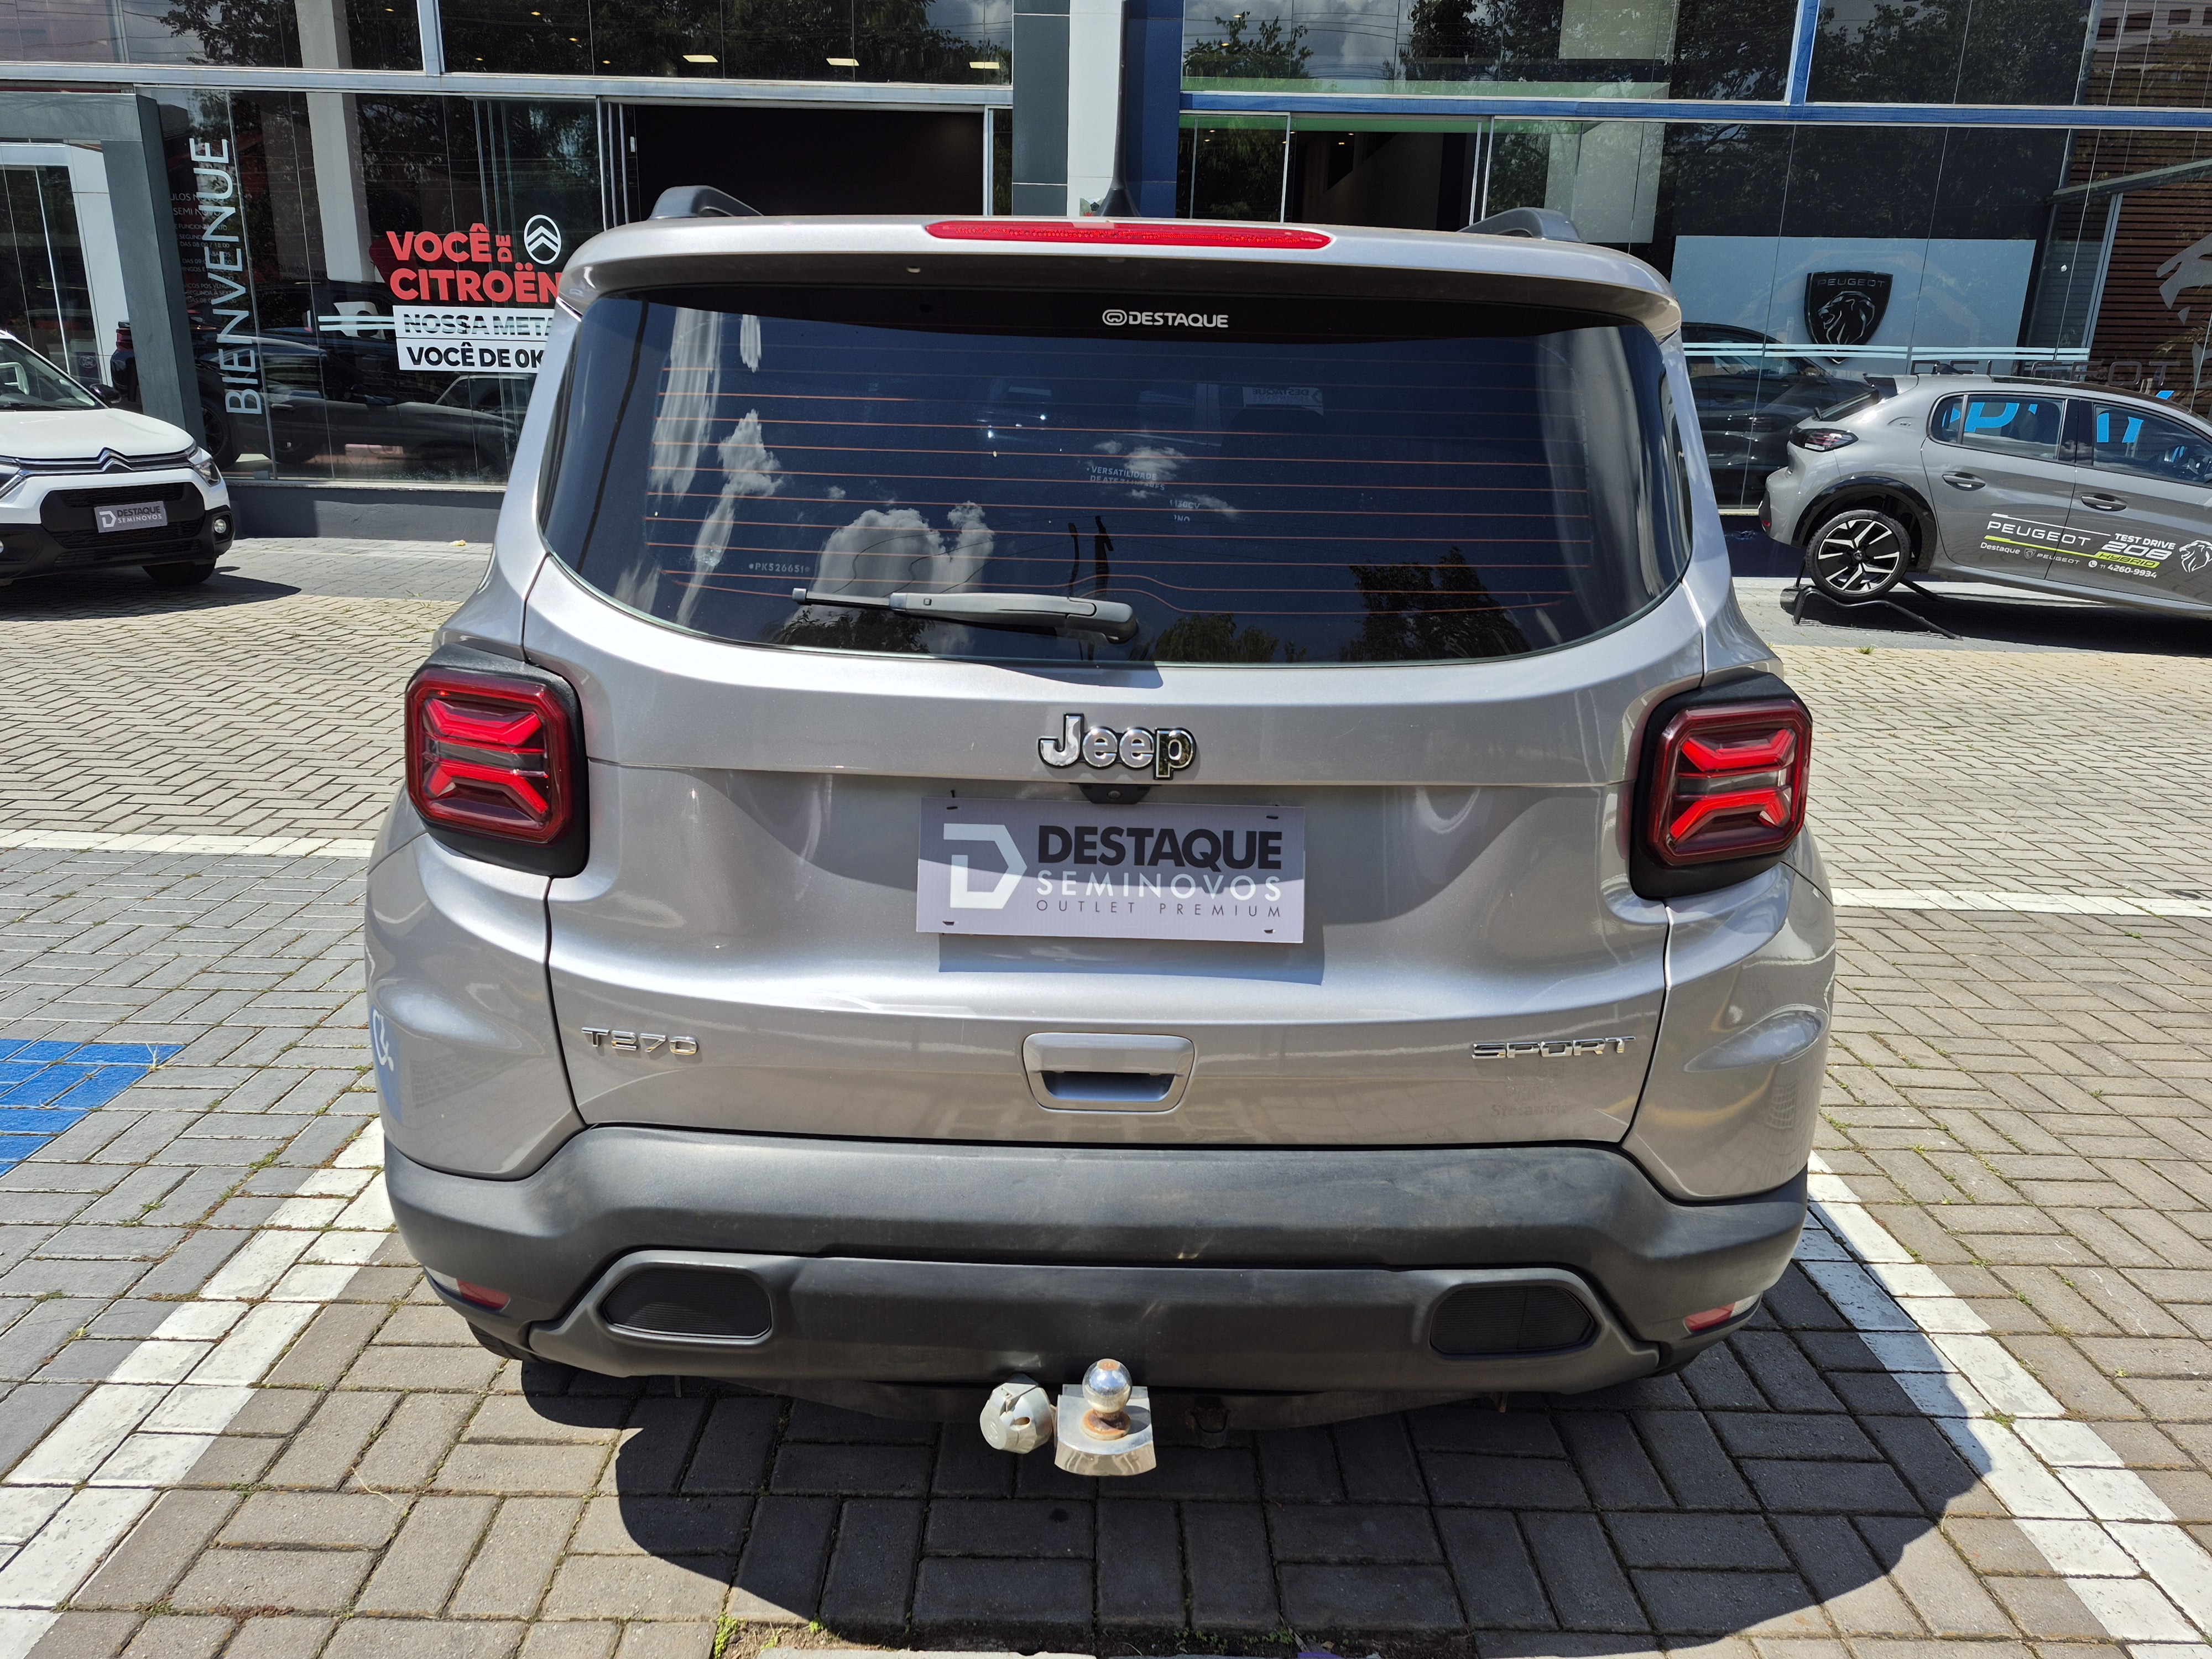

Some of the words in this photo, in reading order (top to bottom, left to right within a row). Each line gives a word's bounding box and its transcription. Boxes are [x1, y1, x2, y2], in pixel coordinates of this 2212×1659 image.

[173, 207, 193, 215] SEMI
[385, 222, 492, 262] VOCÊ
[495, 234, 513, 262] DE
[189, 138, 262, 414] BIENVENUE
[390, 262, 564, 303] CITROËN
[1817, 278, 1886, 288] PEUGEOT
[403, 313, 490, 335] NOSSA
[1129, 311, 1229, 328] DESTAQUE
[406, 342, 475, 367] VOCÊ
[479, 347, 511, 368] DE
[1091, 466, 1157, 481] VERSATILIDADE
[117, 506, 161, 517] DESTAQUE
[118, 514, 162, 523] SEMINOVOS
[1986, 521, 2091, 546] PEUGEOT
[2114, 533, 2142, 545] TEST
[2142, 538, 2176, 550] DRIVE
[1980, 541, 2021, 555] Destaque
[2037, 553, 2080, 565] PEUGEOT
[2099, 552, 2158, 567] HYBRID
[2101, 541, 2173, 561] 208
[2107, 564, 2157, 579] 4260-9934
[1038, 712, 1196, 780] Jeep
[1038, 825, 1282, 872] DESTAQUE
[1036, 870, 1281, 901] SEMINOVOS
[1036, 900, 1135, 914] OUTLET
[1159, 903, 1280, 917] PREMIUM
[581, 1026, 698, 1055] T270
[1471, 1036, 1636, 1059] SPORT
